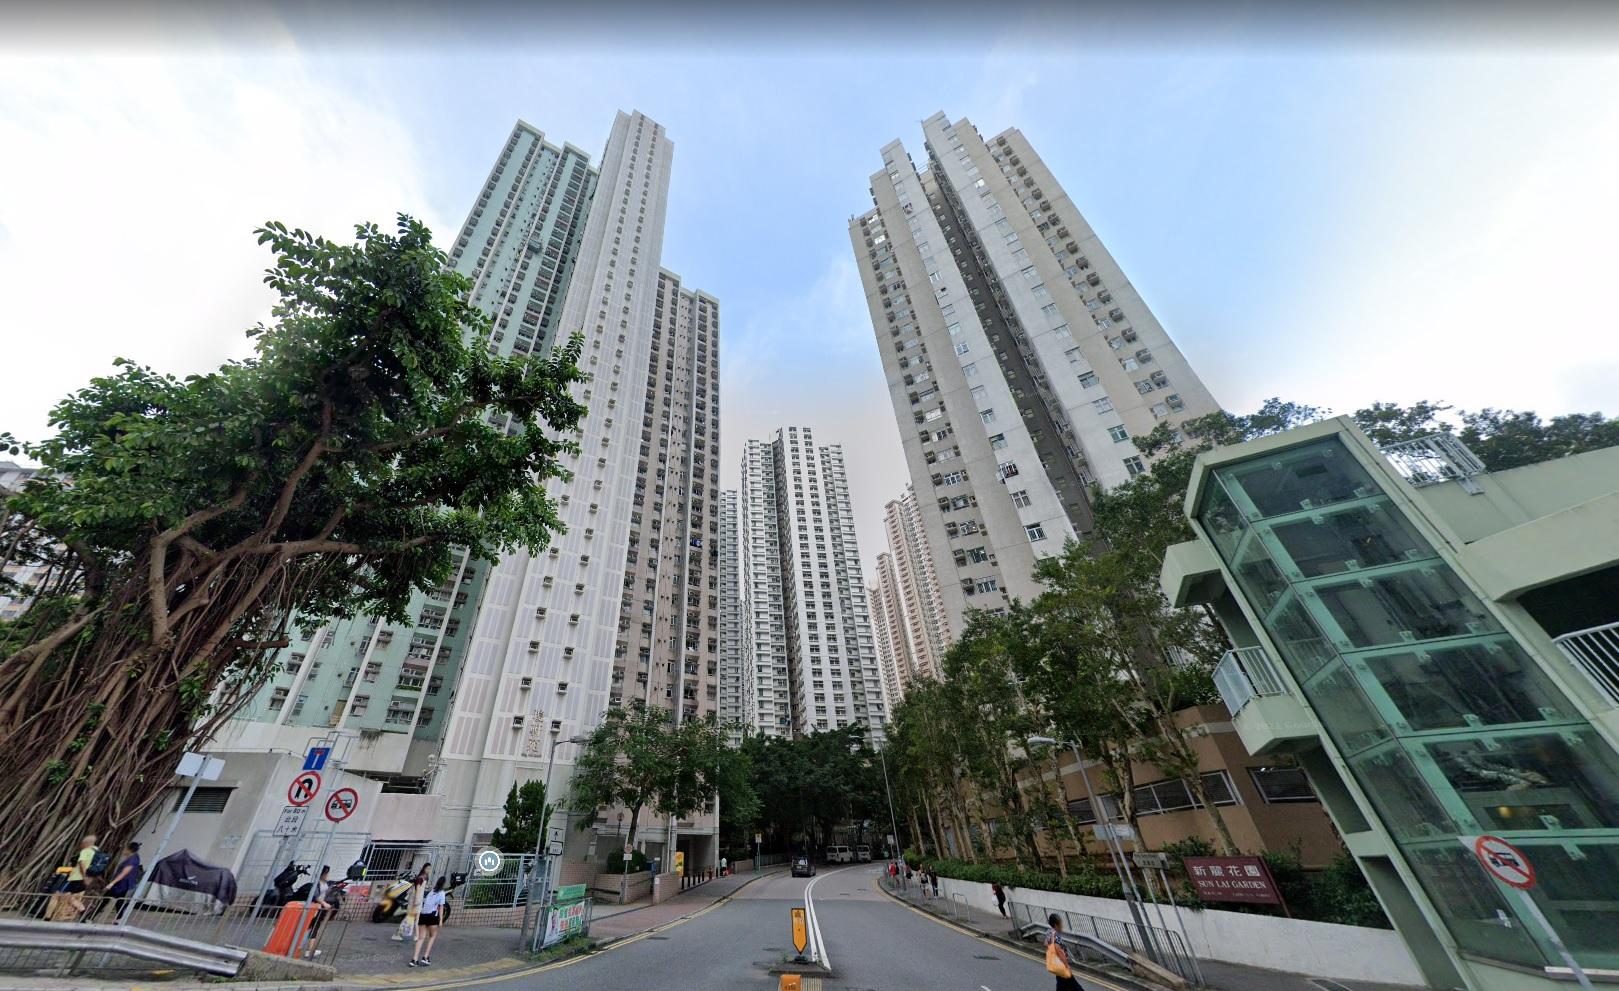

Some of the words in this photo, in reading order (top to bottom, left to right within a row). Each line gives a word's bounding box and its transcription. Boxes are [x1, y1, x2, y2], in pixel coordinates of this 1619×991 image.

[1191, 864, 1261, 877] 新麗花園
[1198, 880, 1215, 888] SUN
[1216, 880, 1230, 888] LAI
[1231, 880, 1267, 889] GARDEN
